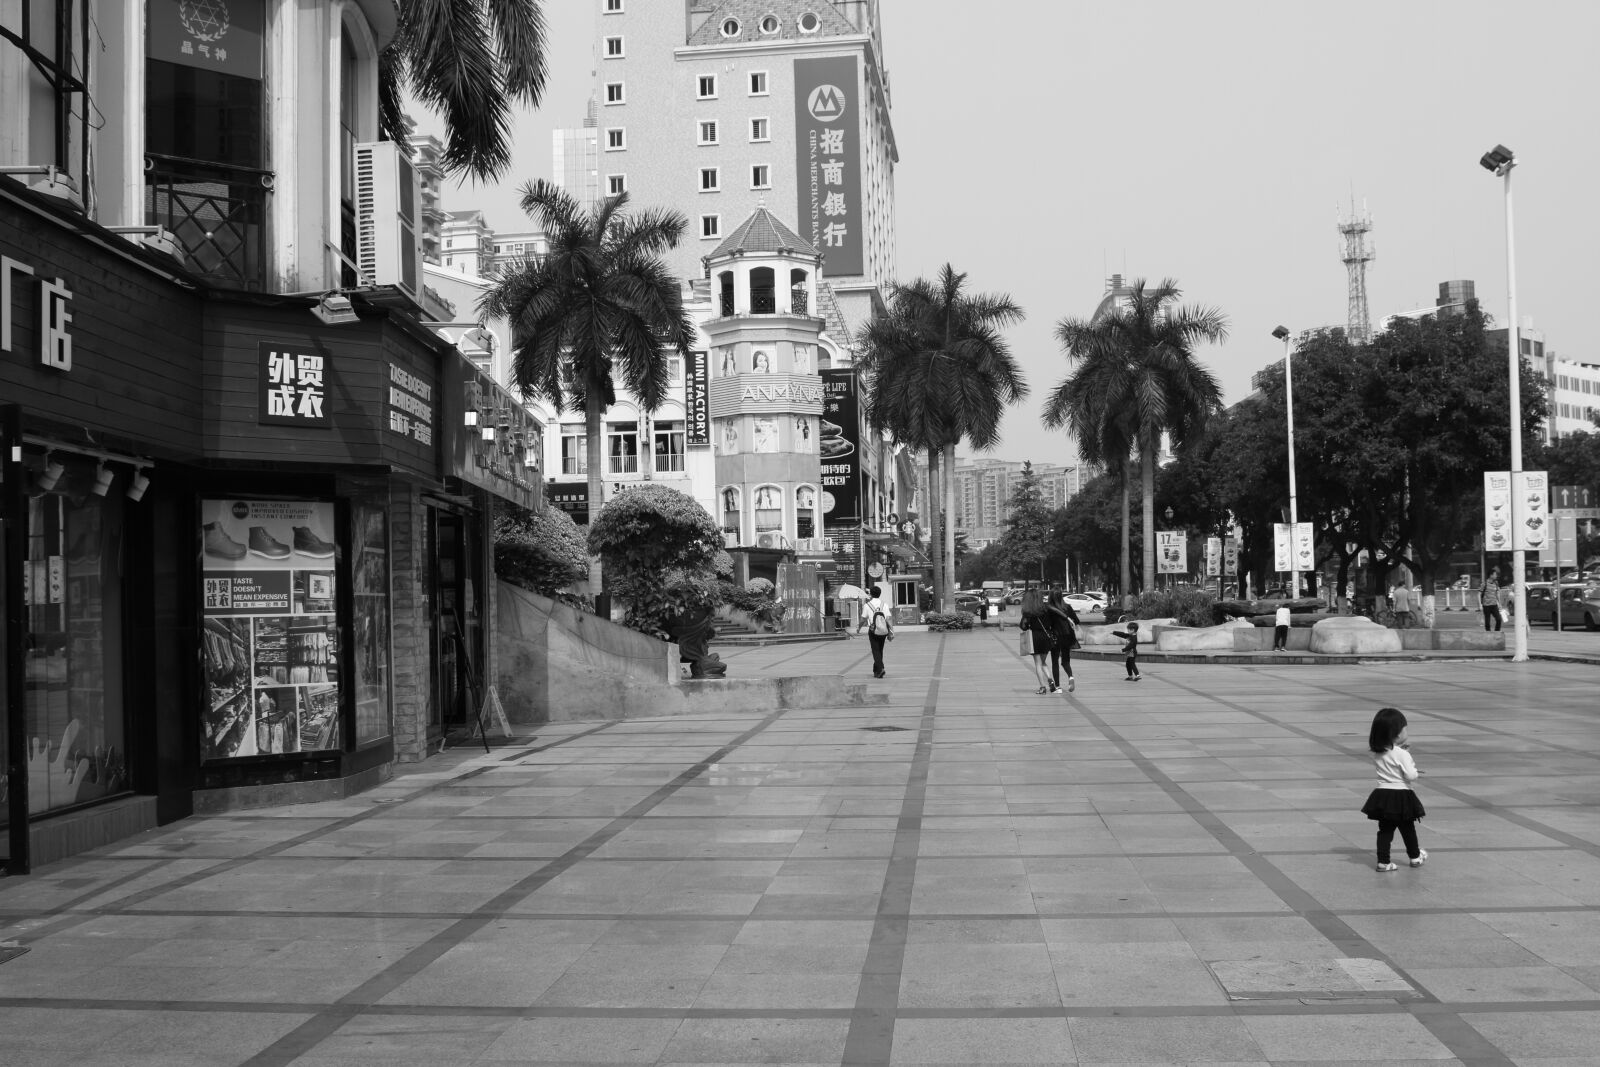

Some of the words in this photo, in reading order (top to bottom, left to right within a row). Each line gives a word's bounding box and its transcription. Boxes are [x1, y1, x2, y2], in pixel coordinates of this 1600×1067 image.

[809, 129, 817, 160] CHINA
[810, 161, 819, 220] MERCHANTS
[812, 221, 820, 248] BANK
[268, 351, 324, 387] 外贸
[695, 353, 705, 381] MINI
[268, 384, 324, 418] 成衣
[831, 382, 847, 392] LIFE
[696, 384, 706, 437] FACTORY
[206, 579, 230, 594] 外贸
